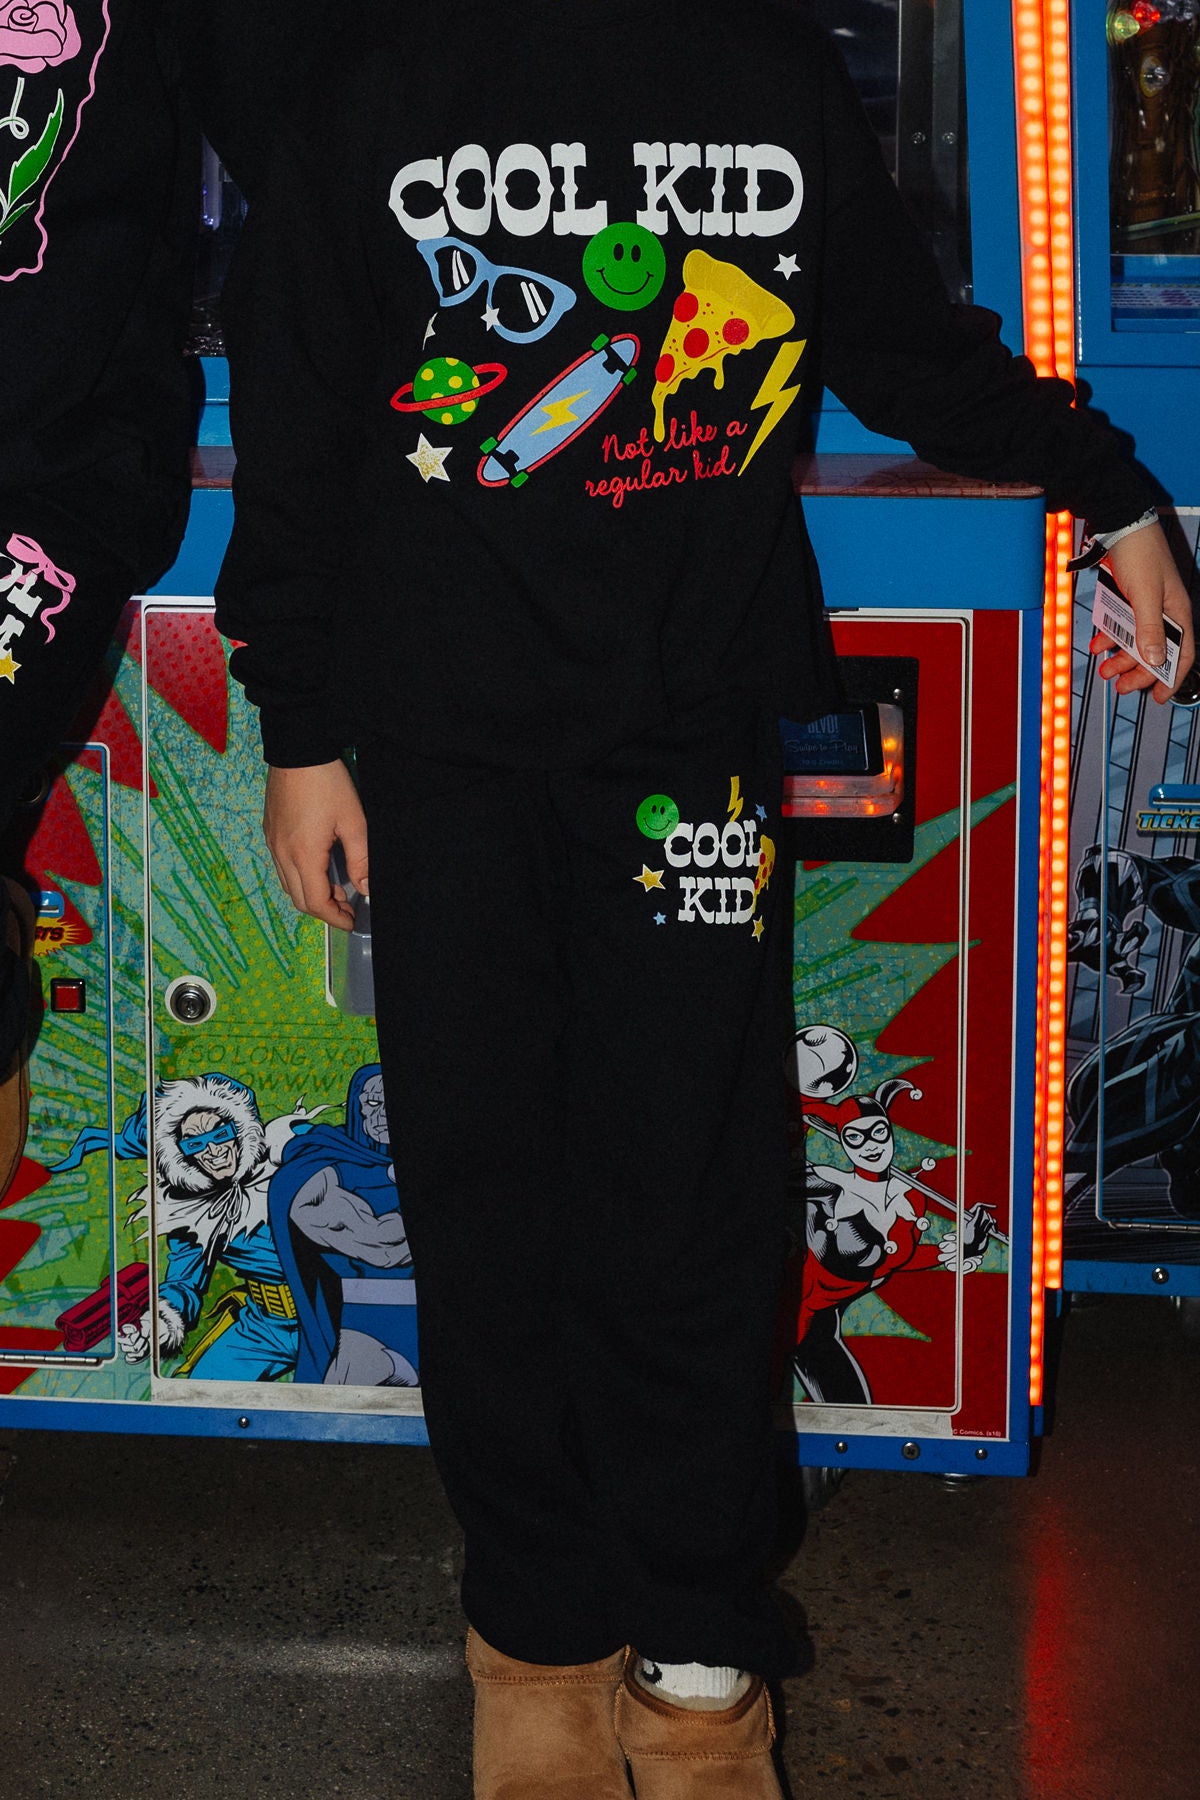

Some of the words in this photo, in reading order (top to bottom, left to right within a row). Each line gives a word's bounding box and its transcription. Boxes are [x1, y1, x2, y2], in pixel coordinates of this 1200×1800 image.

[388, 141, 609, 242] COOL
[633, 141, 805, 238] KID
[601, 433, 655, 464] Not
[662, 410, 718, 452] like
[725, 419, 749, 438] a
[583, 456, 689, 509] regular
[693, 446, 737, 483] kid
[663, 818, 762, 869] COOL
[677, 875, 756, 925] KID
